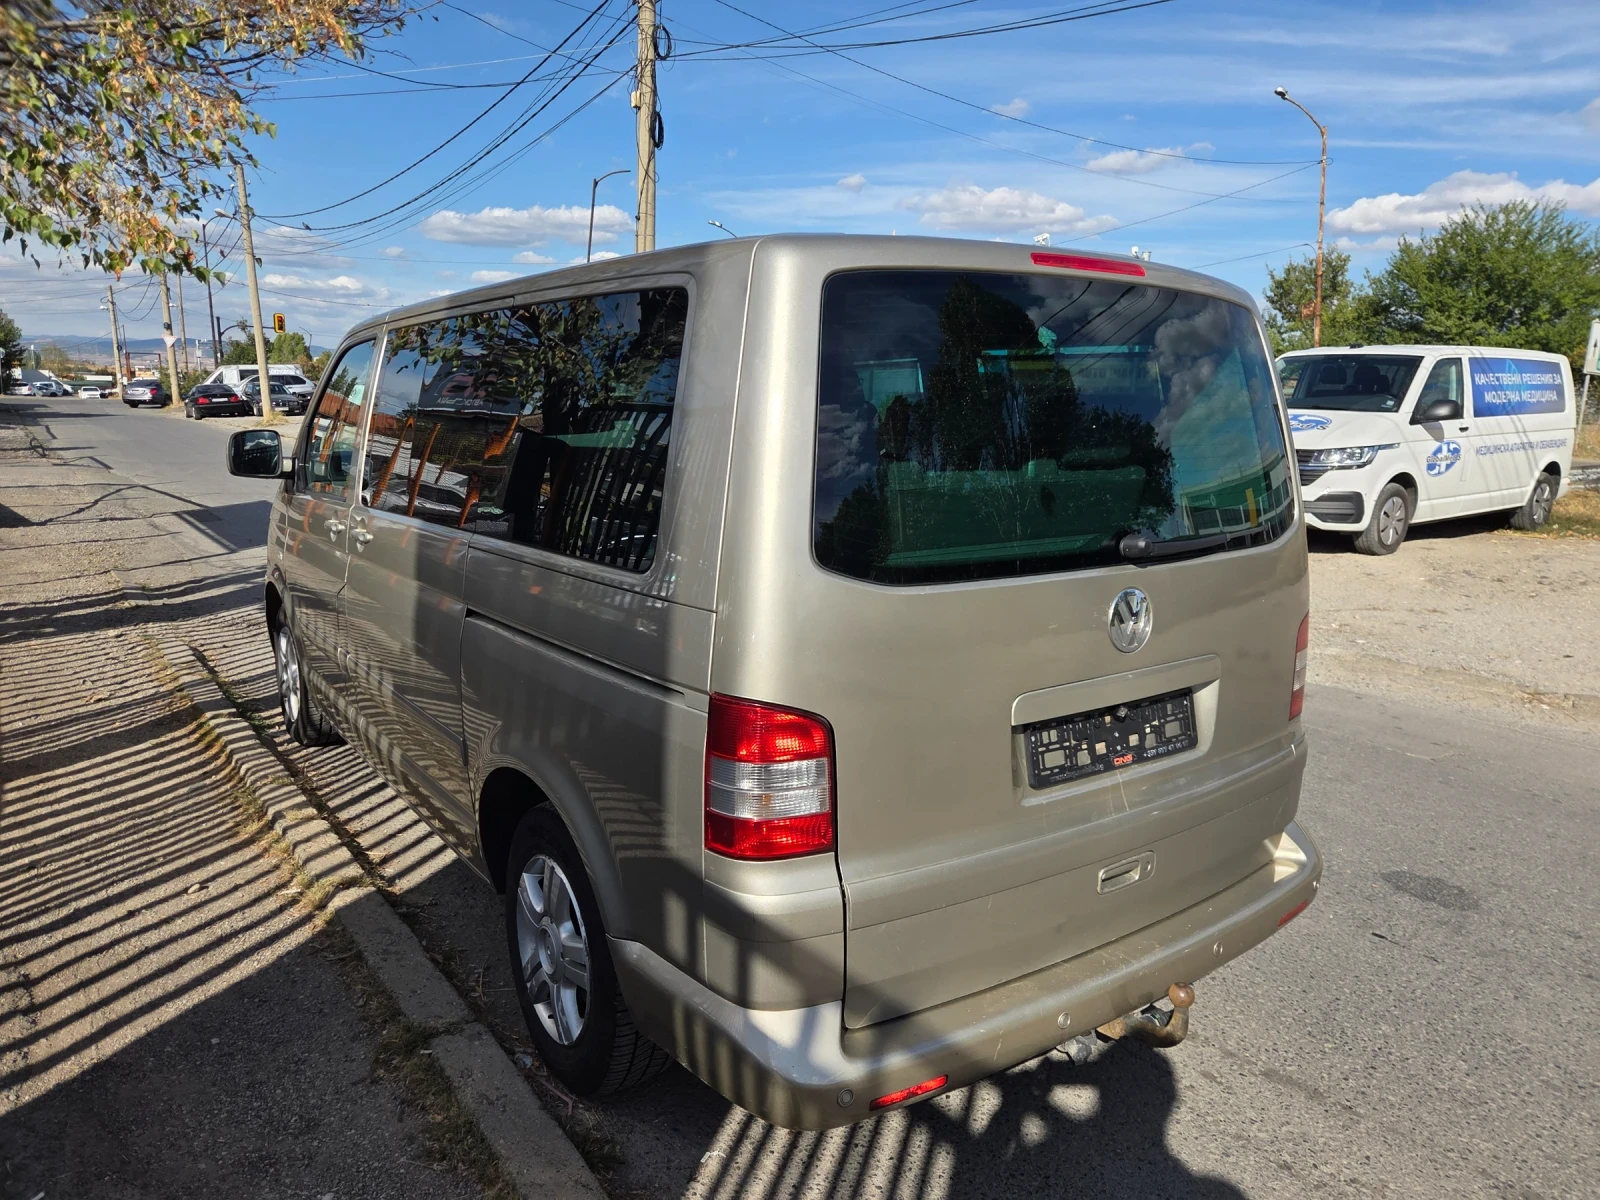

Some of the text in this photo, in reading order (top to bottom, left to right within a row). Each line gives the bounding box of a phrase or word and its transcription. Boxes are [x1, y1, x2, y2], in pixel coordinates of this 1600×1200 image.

[1474, 373, 1562, 386] КАЧЕСТВЕНИ РЕШЕНИЯ ЗА
[1484, 390, 1558, 404] МОДЕРНА МЕДИЦИНА
